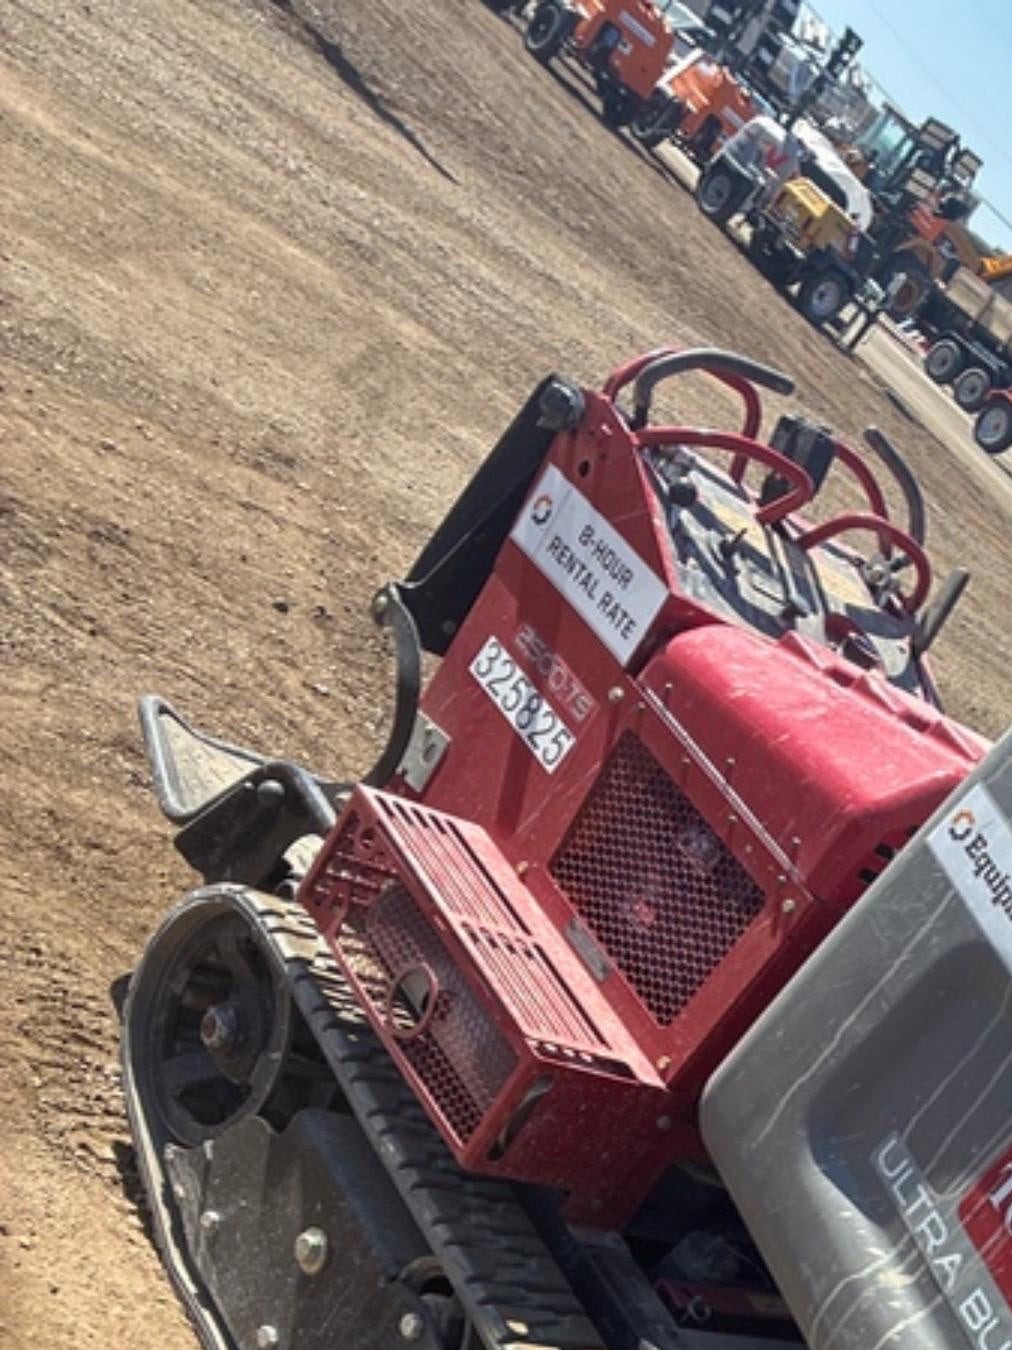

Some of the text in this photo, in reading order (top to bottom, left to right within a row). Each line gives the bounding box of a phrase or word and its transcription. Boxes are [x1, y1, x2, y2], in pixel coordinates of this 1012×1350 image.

[546, 535, 637, 640] RENTAL RATE
[577, 523, 635, 591] 8-HOUR
[473, 641, 572, 767] 325825
[877, 1137, 963, 1290] ULTRA
